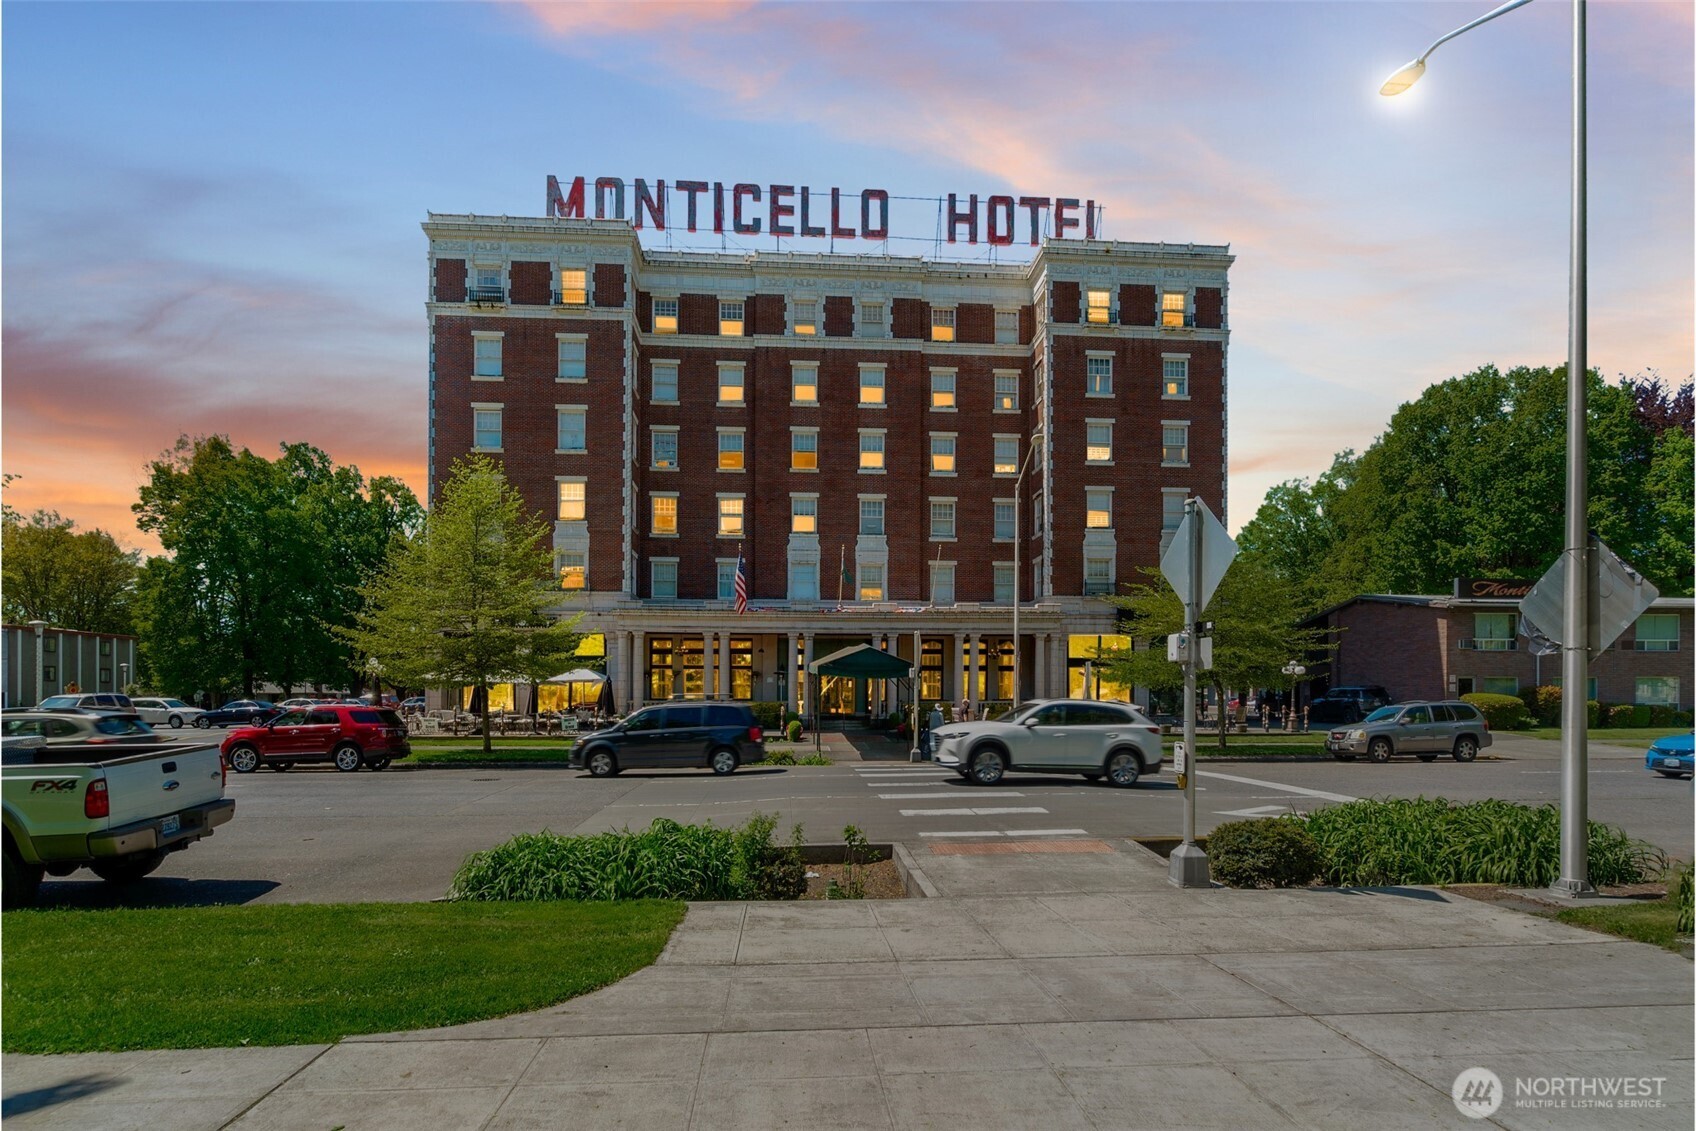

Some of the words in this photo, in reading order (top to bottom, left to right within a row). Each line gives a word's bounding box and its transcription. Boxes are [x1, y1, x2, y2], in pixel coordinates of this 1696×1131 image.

[547, 175, 888, 240] MONTICELLO
[1472, 581, 1532, 596] Monti
[31, 780, 78, 791] FX4
